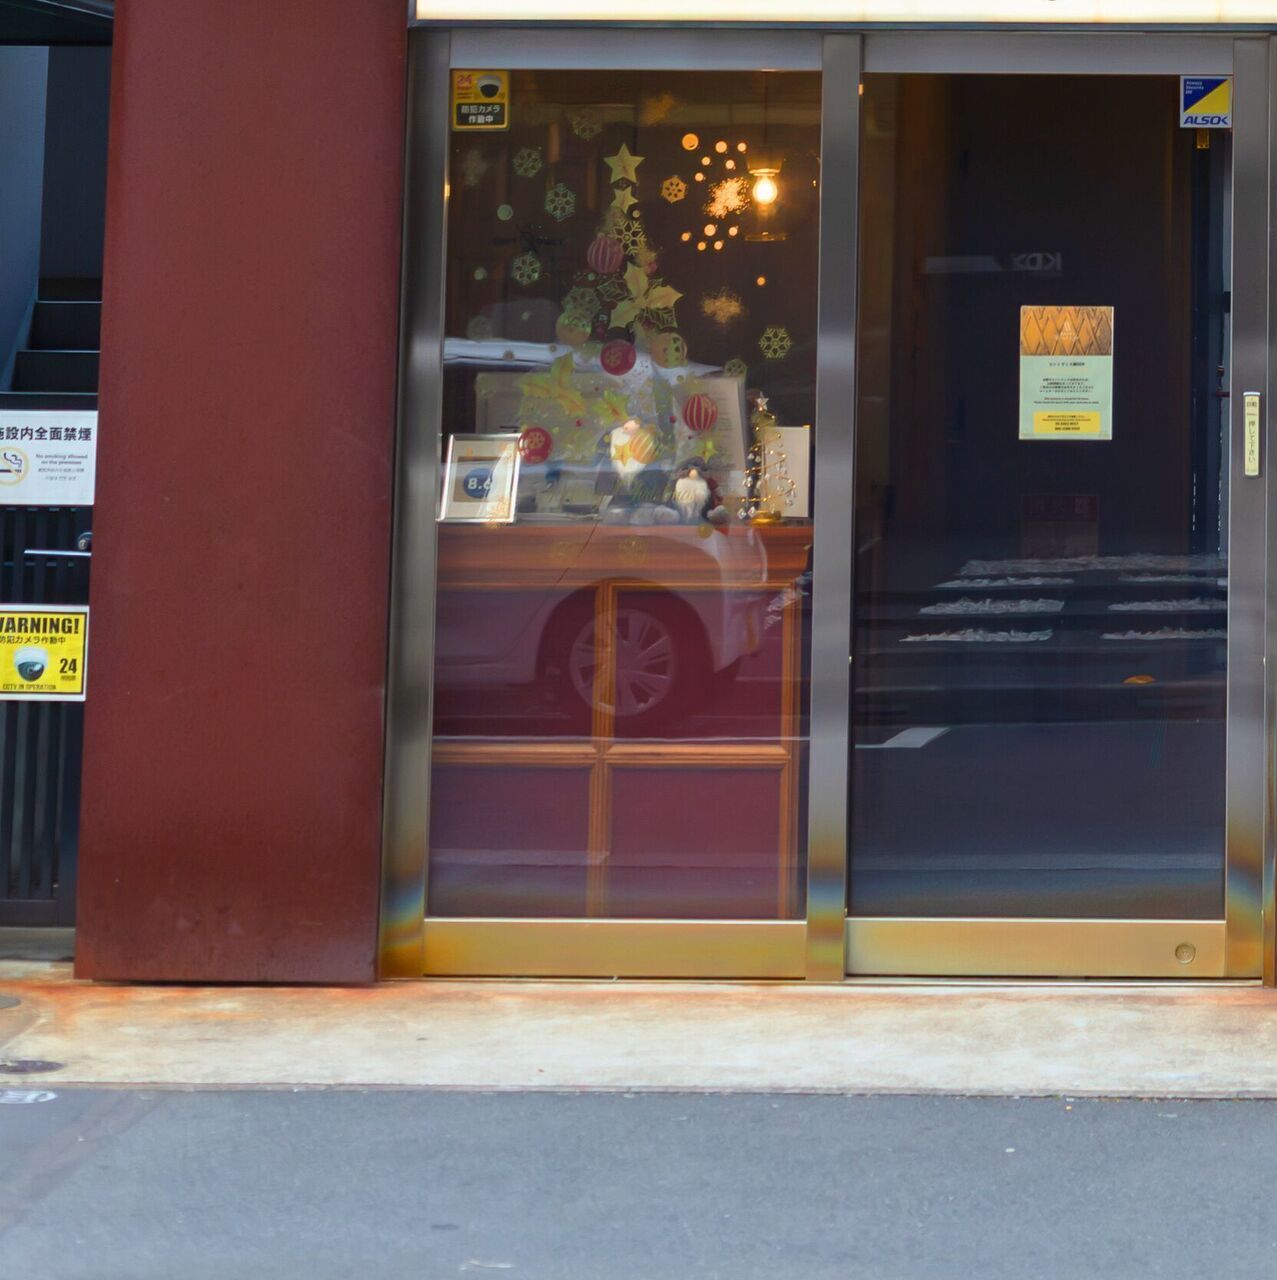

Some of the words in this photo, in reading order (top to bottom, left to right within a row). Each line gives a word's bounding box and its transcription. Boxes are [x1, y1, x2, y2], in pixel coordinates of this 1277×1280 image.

[461, 105, 501, 114] 防犯カメラ
[1183, 116, 1229, 126] ALSOK
[59, 658, 78, 674] 24
